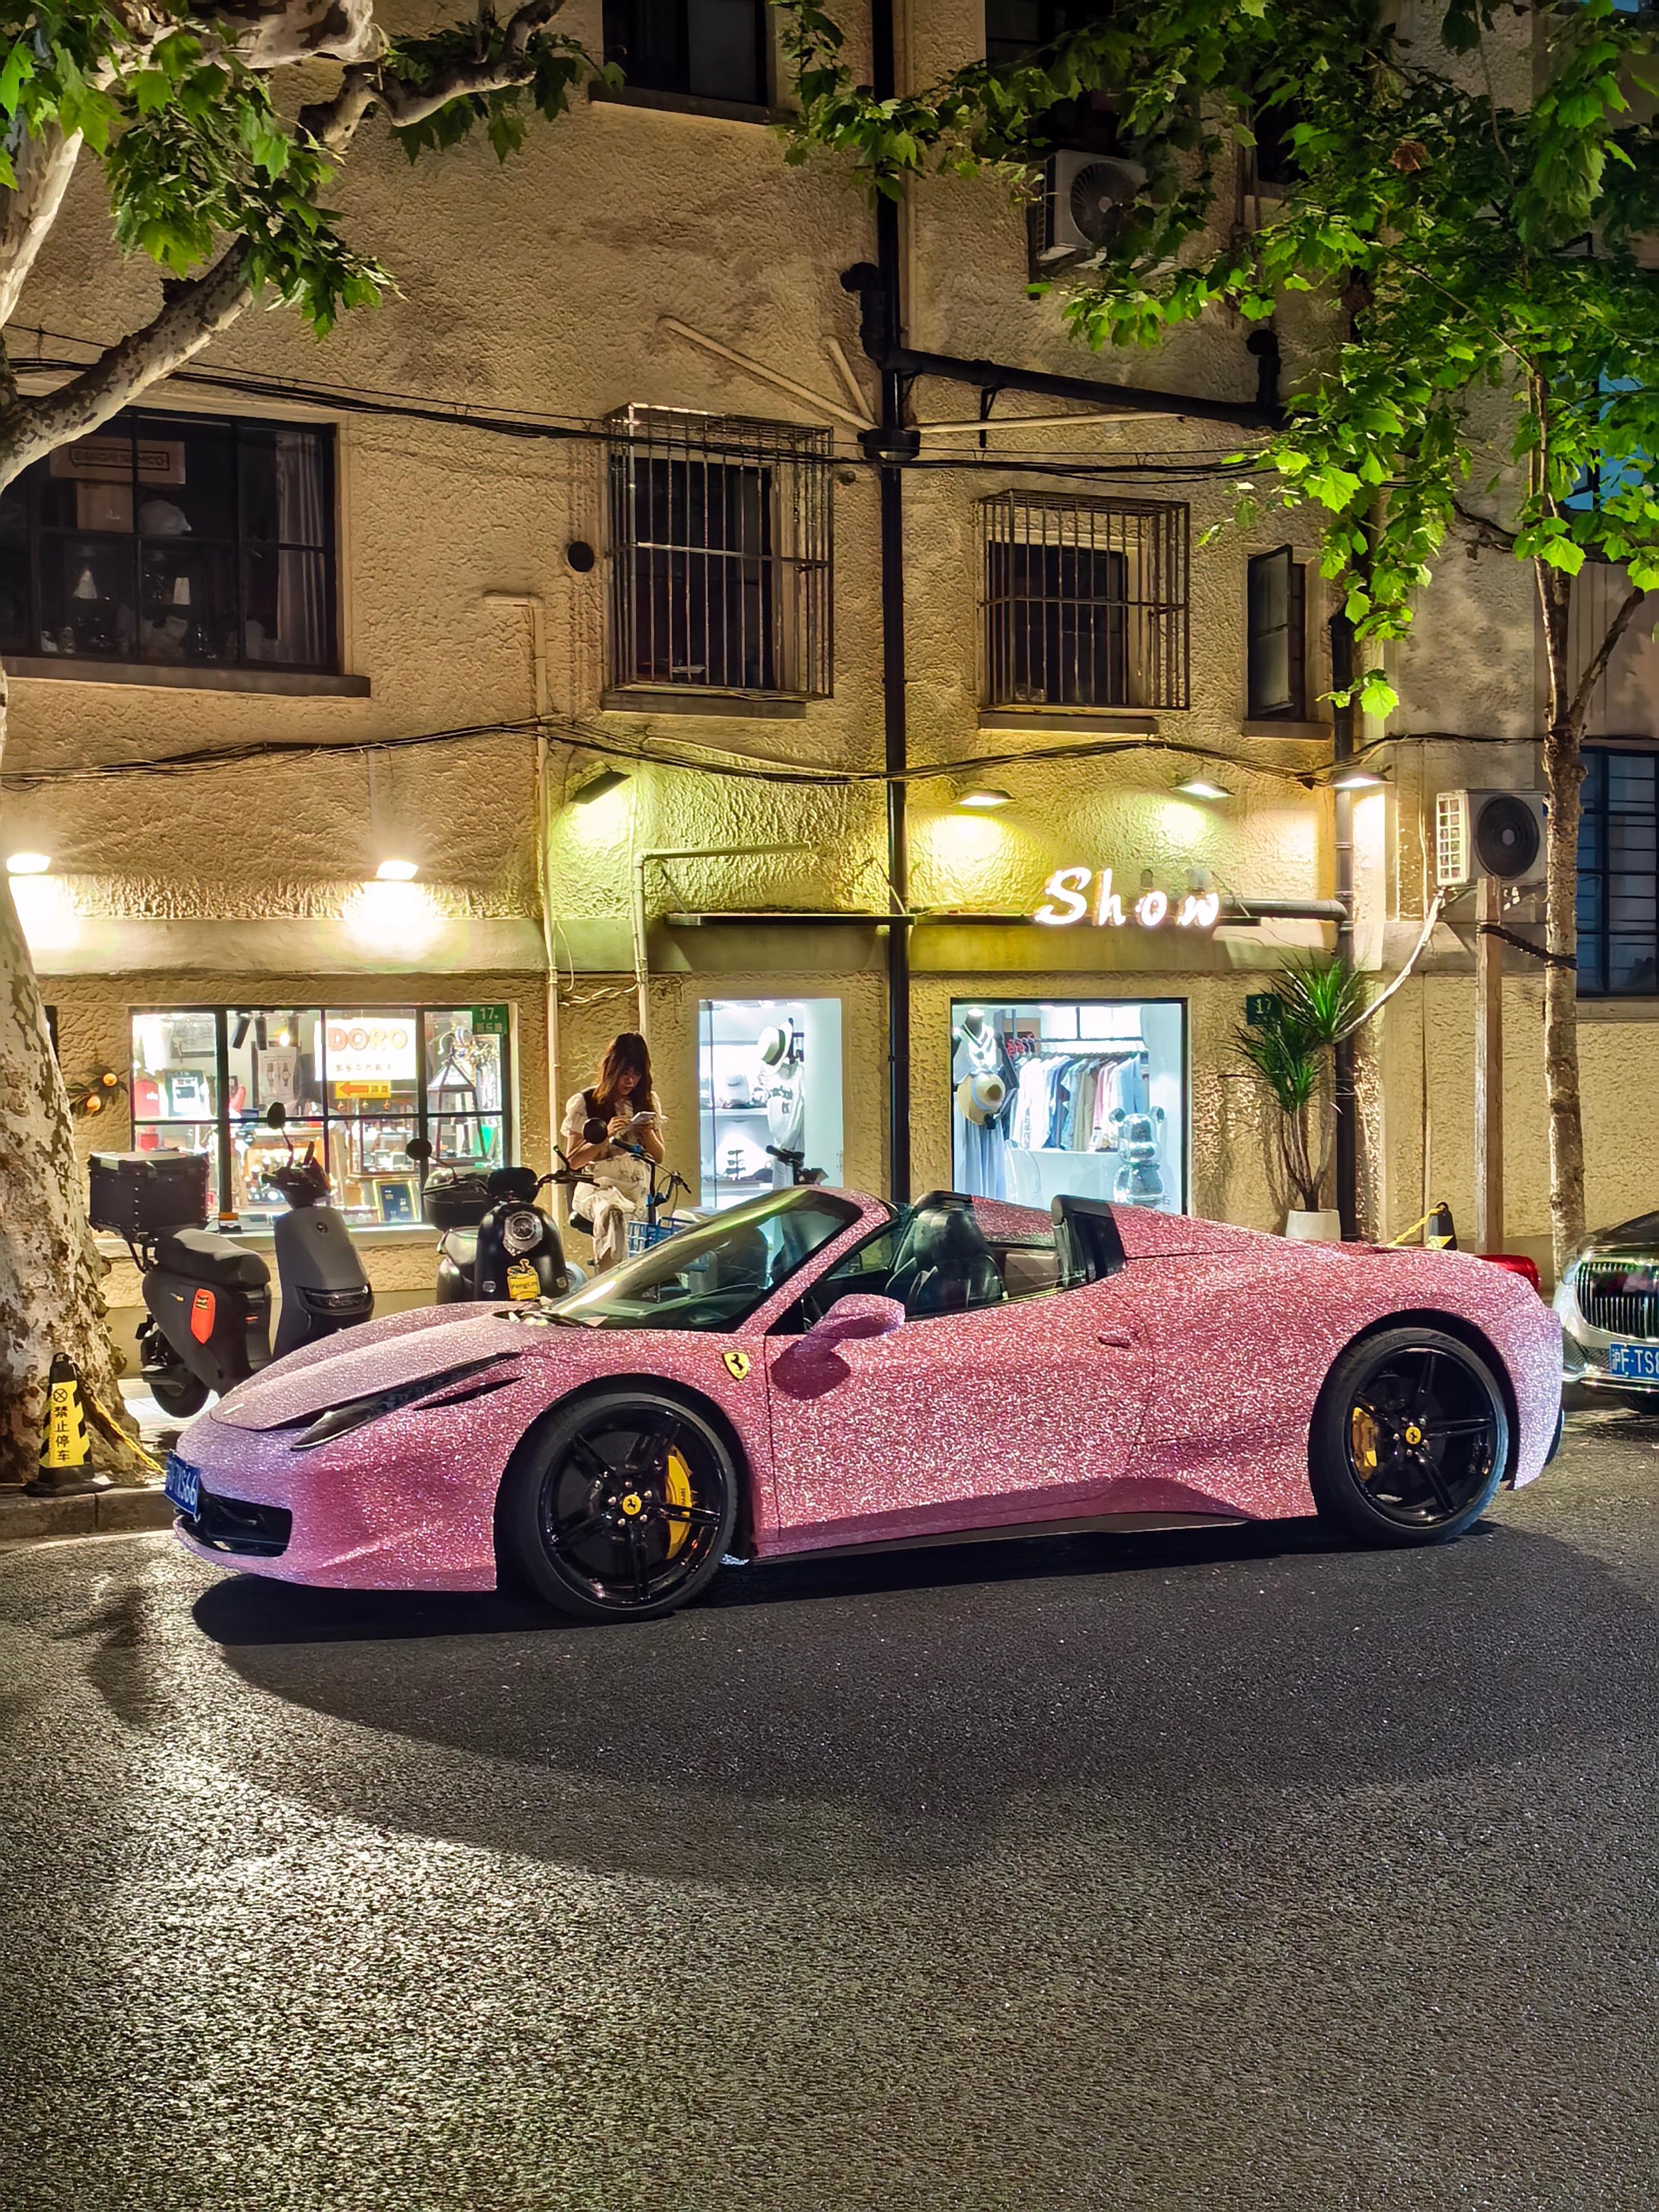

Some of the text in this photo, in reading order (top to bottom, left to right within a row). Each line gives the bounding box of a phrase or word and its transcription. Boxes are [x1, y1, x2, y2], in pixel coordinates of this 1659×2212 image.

[1034, 867, 1219, 926] Show
[1256, 998, 1271, 1014] 17
[327, 1027, 408, 1051] DORO
[53, 1405, 71, 1462] 禁止停车
